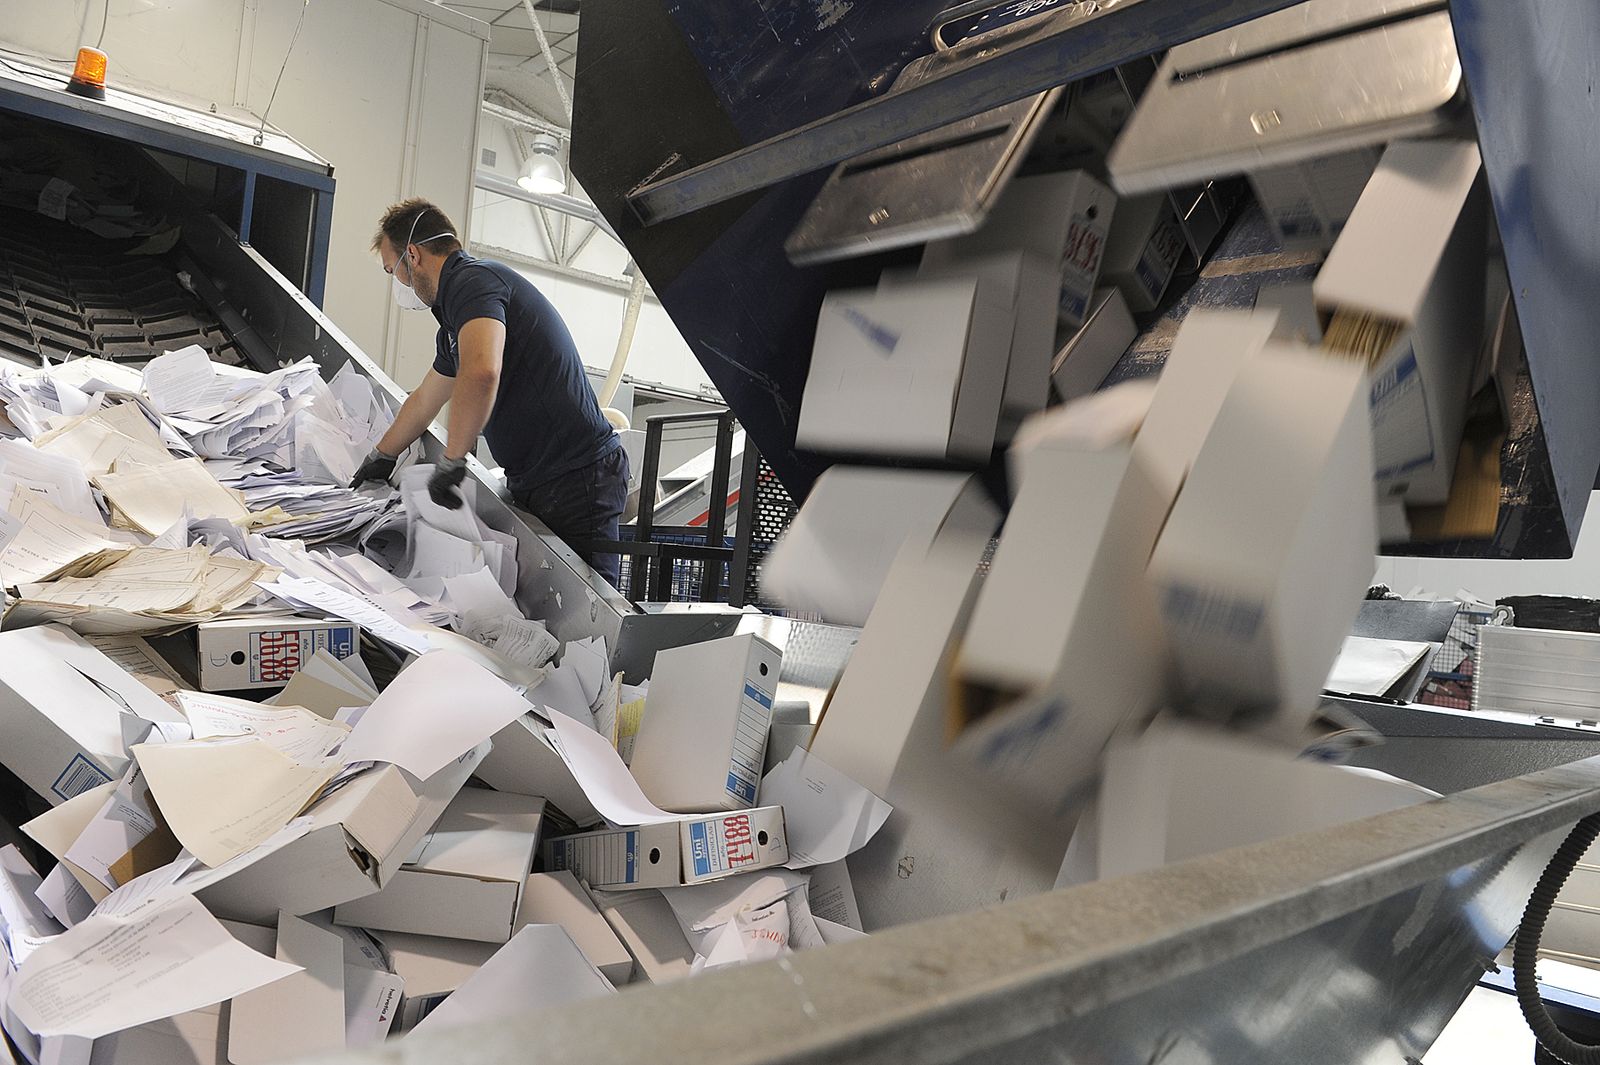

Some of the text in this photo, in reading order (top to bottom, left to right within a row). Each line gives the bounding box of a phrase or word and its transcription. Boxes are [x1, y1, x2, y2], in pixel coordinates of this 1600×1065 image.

[260, 631, 299, 682] 5688
[694, 838, 703, 860] Uni
[723, 814, 754, 869] 7488
[382, 988, 395, 1015] helvetia
